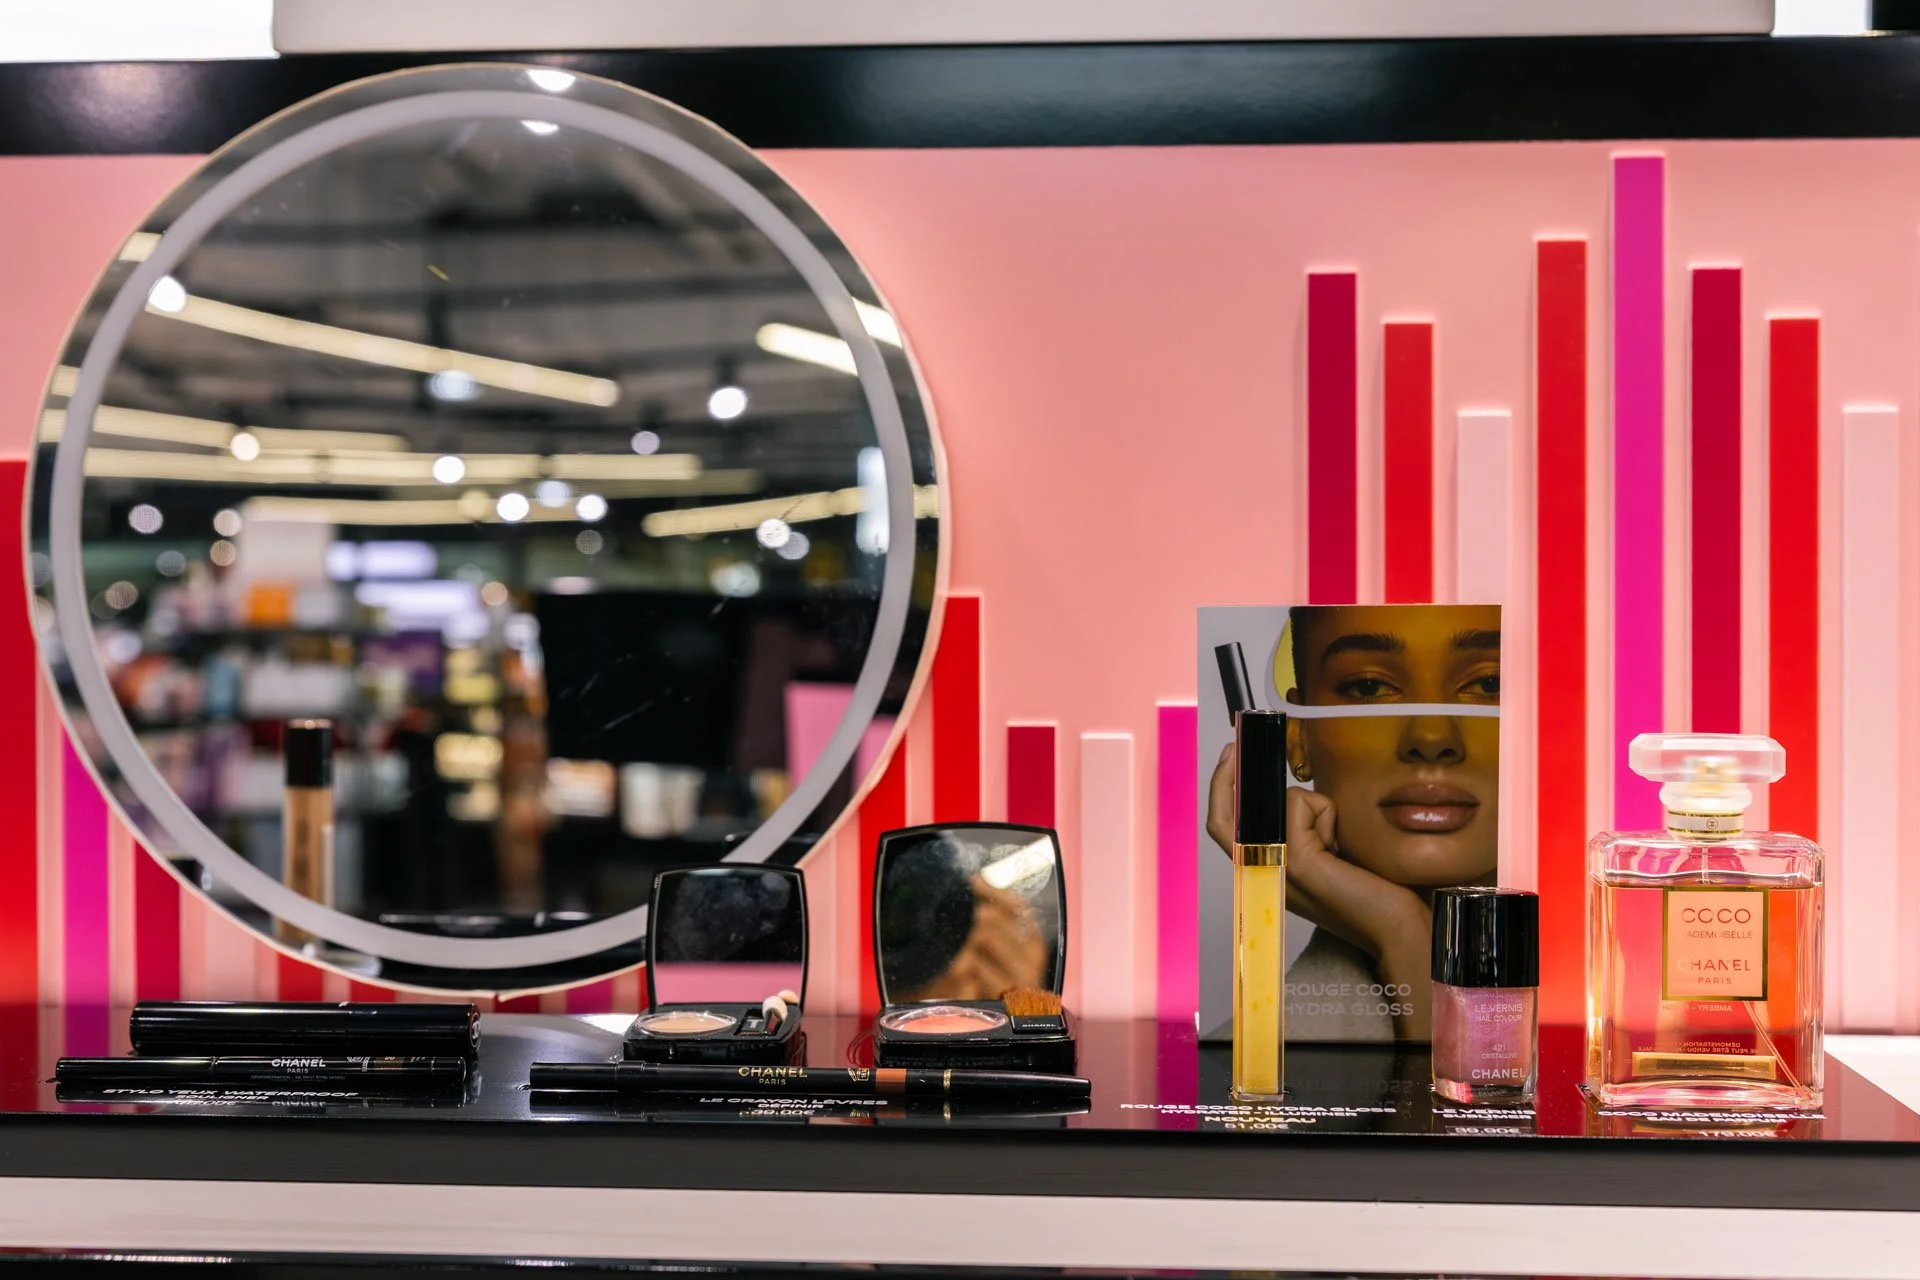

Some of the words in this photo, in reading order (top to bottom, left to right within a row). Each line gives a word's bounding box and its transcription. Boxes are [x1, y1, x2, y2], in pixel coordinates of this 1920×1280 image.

[1681, 907, 1751, 924] COCO
[1697, 977, 1732, 985] PARIS
[1285, 983, 1351, 997] ROUGE
[1356, 983, 1412, 997] COCO
[1286, 1002, 1347, 1016] HYDRA
[1351, 1002, 1414, 1016] GLOSS
[1474, 1004, 1487, 1013] LE
[1489, 1003, 1523, 1013] VERNIS
[271, 1059, 327, 1068] CHANEL
[738, 1066, 808, 1078] CHANEL
[1471, 1068, 1526, 1079] CHANEL
[759, 1078, 786, 1086] PARIS
[1204, 1116, 1317, 1124] NOUVEAU
[1661, 1111, 1828, 1120] MADEMOISELLE
